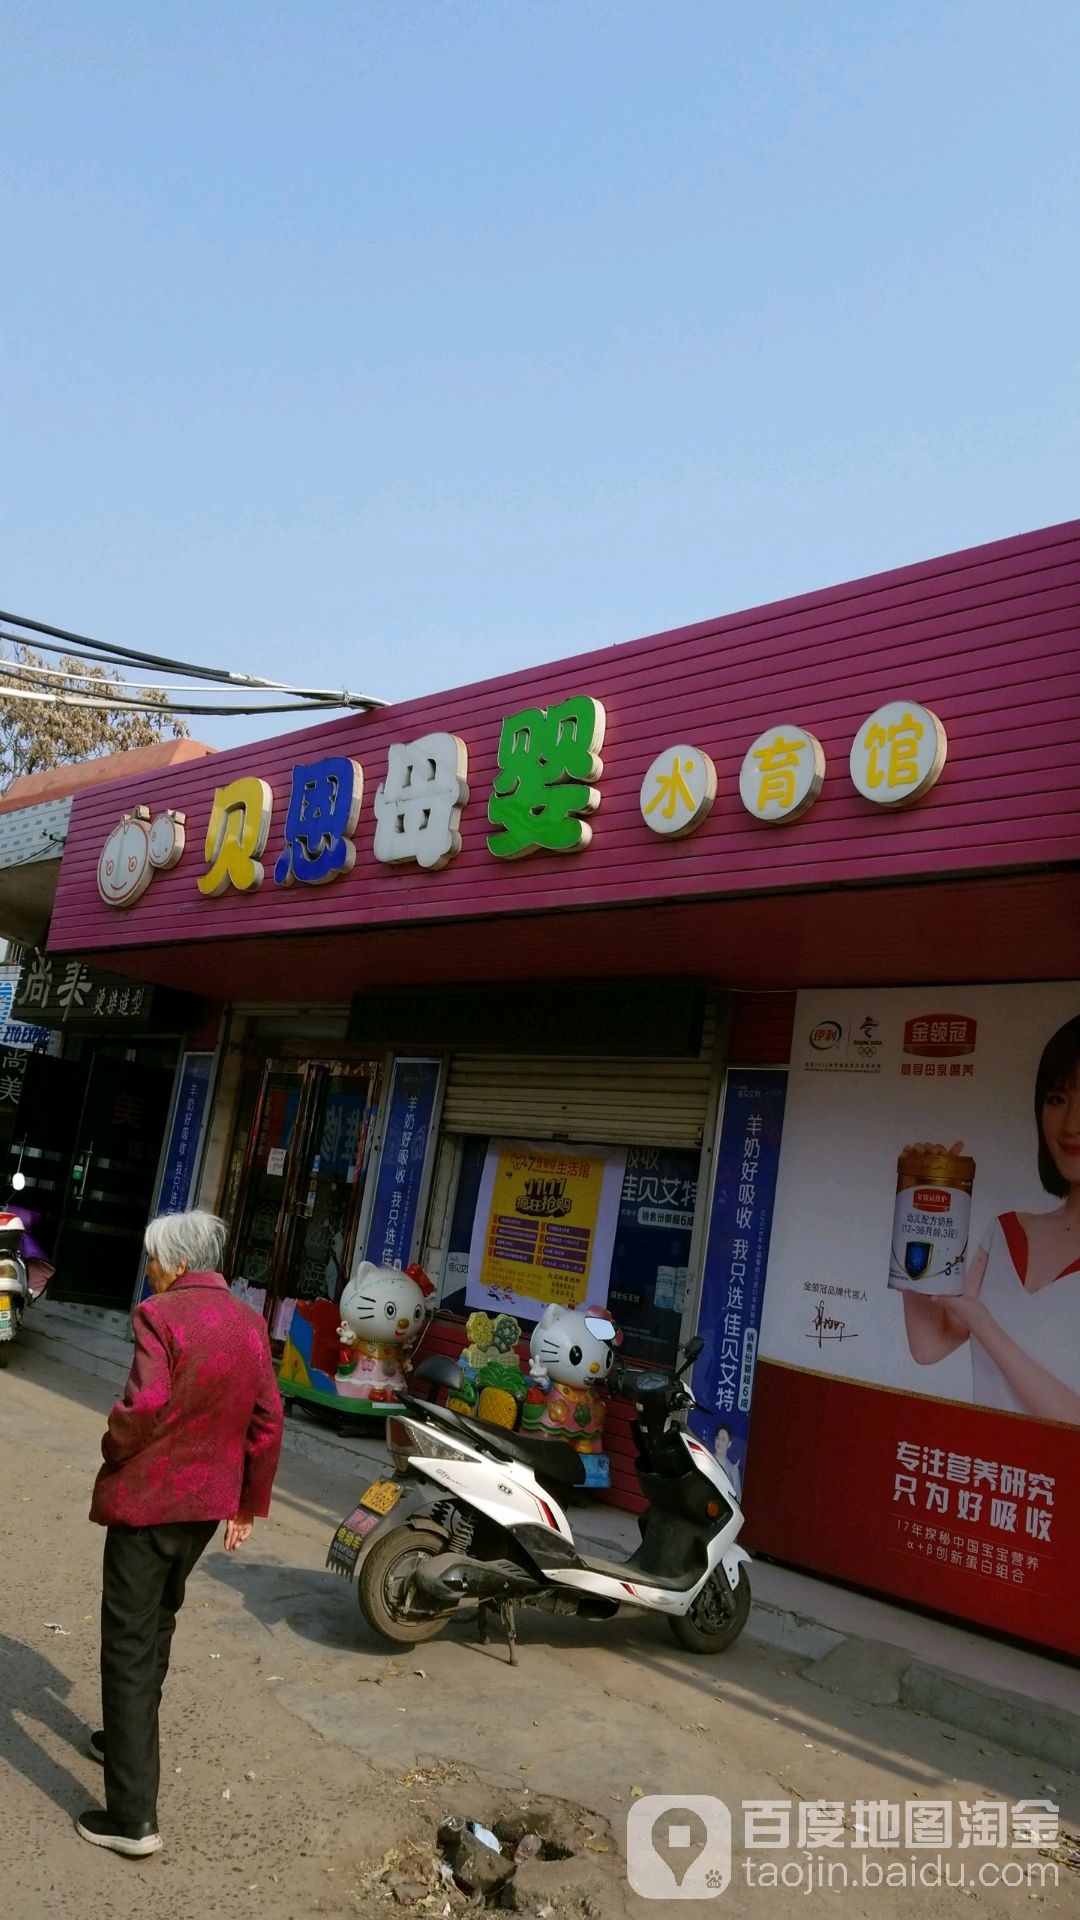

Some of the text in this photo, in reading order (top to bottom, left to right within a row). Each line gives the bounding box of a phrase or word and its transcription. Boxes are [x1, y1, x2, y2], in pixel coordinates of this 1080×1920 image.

[197, 694, 930, 899] 贝恩母婴 水育馆
[814, 1028, 837, 1042] 伊利
[911, 1021, 968, 1042] 金领冠
[0, 1050, 28, 1105] 尚美
[900, 1063, 974, 1077] 倡导母乳喂养
[395, 1095, 419, 1186] 羊奶好吸收
[734, 1113, 763, 1231] 羊奶好吸收
[516, 1196, 573, 1215] 疯狂抢购
[906, 1213, 954, 1227] 幼儿配方奶粉
[803, 1281, 869, 1302] 金领冠品牌代言人
[944, 1261, 952, 1276] 3
[715, 1238, 749, 1414] 我只选佳贝艾特
[739, 1333, 756, 1409] 销售份额超6成
[895, 1440, 1057, 1507] 专注营养研究
[892, 1473, 1055, 1543] 只为好吸收
[896, 1518, 1040, 1571] 17年探秘中国宝宝营养
